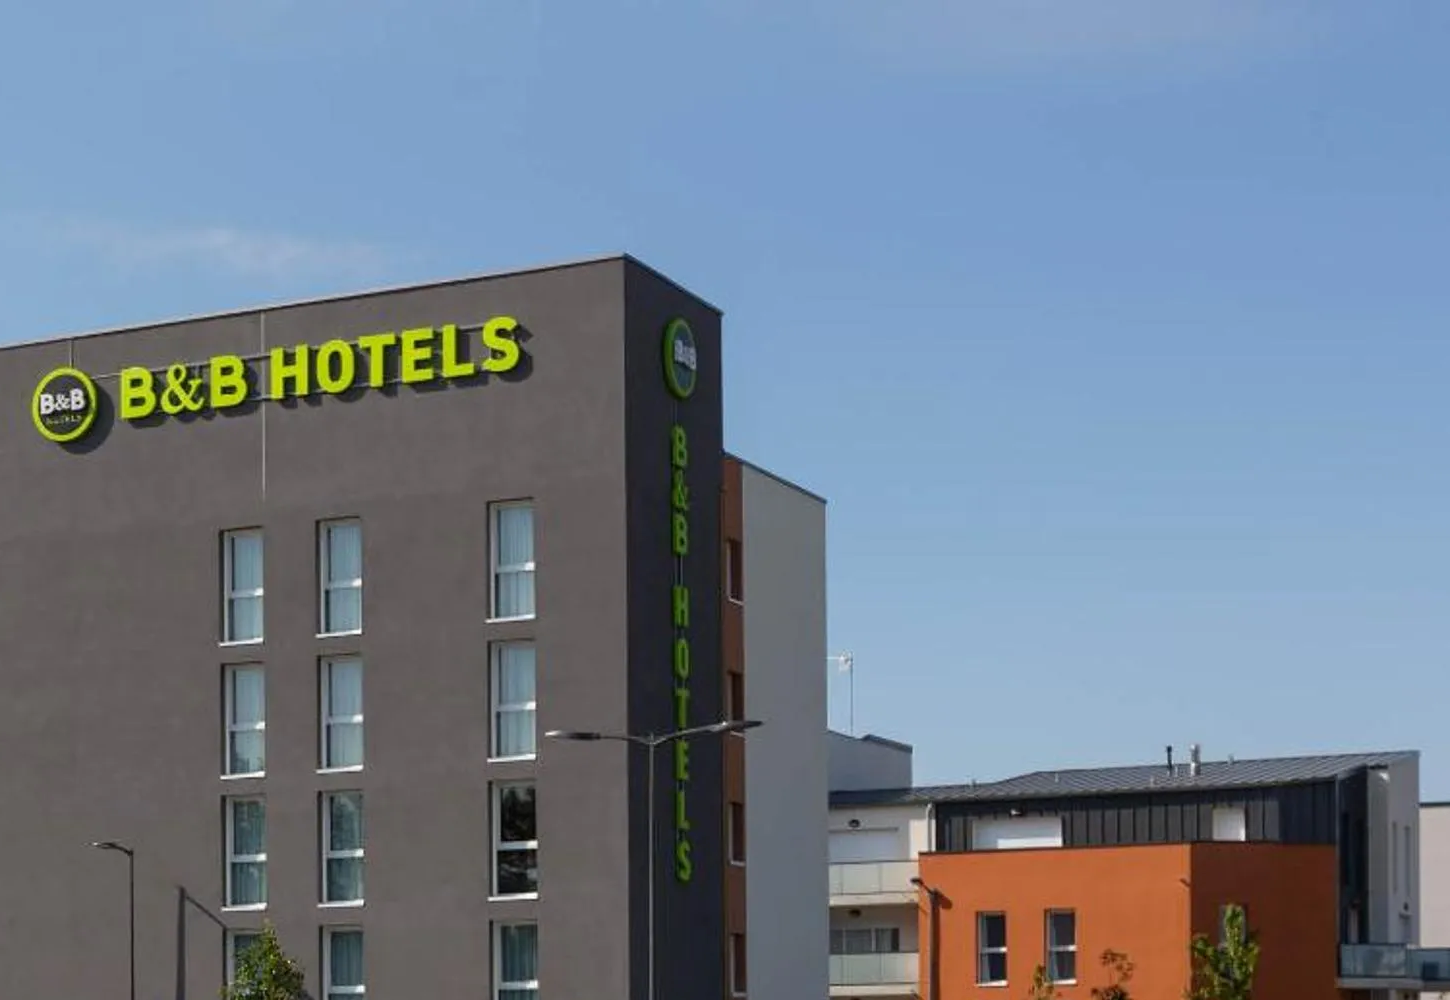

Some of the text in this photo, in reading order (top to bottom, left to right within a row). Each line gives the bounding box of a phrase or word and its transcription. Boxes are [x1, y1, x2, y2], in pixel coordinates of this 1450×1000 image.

[40, 388, 86, 415] B&B
[121, 316, 520, 419] B&B HOTELS
[671, 425, 692, 881] B&B HOTELS
